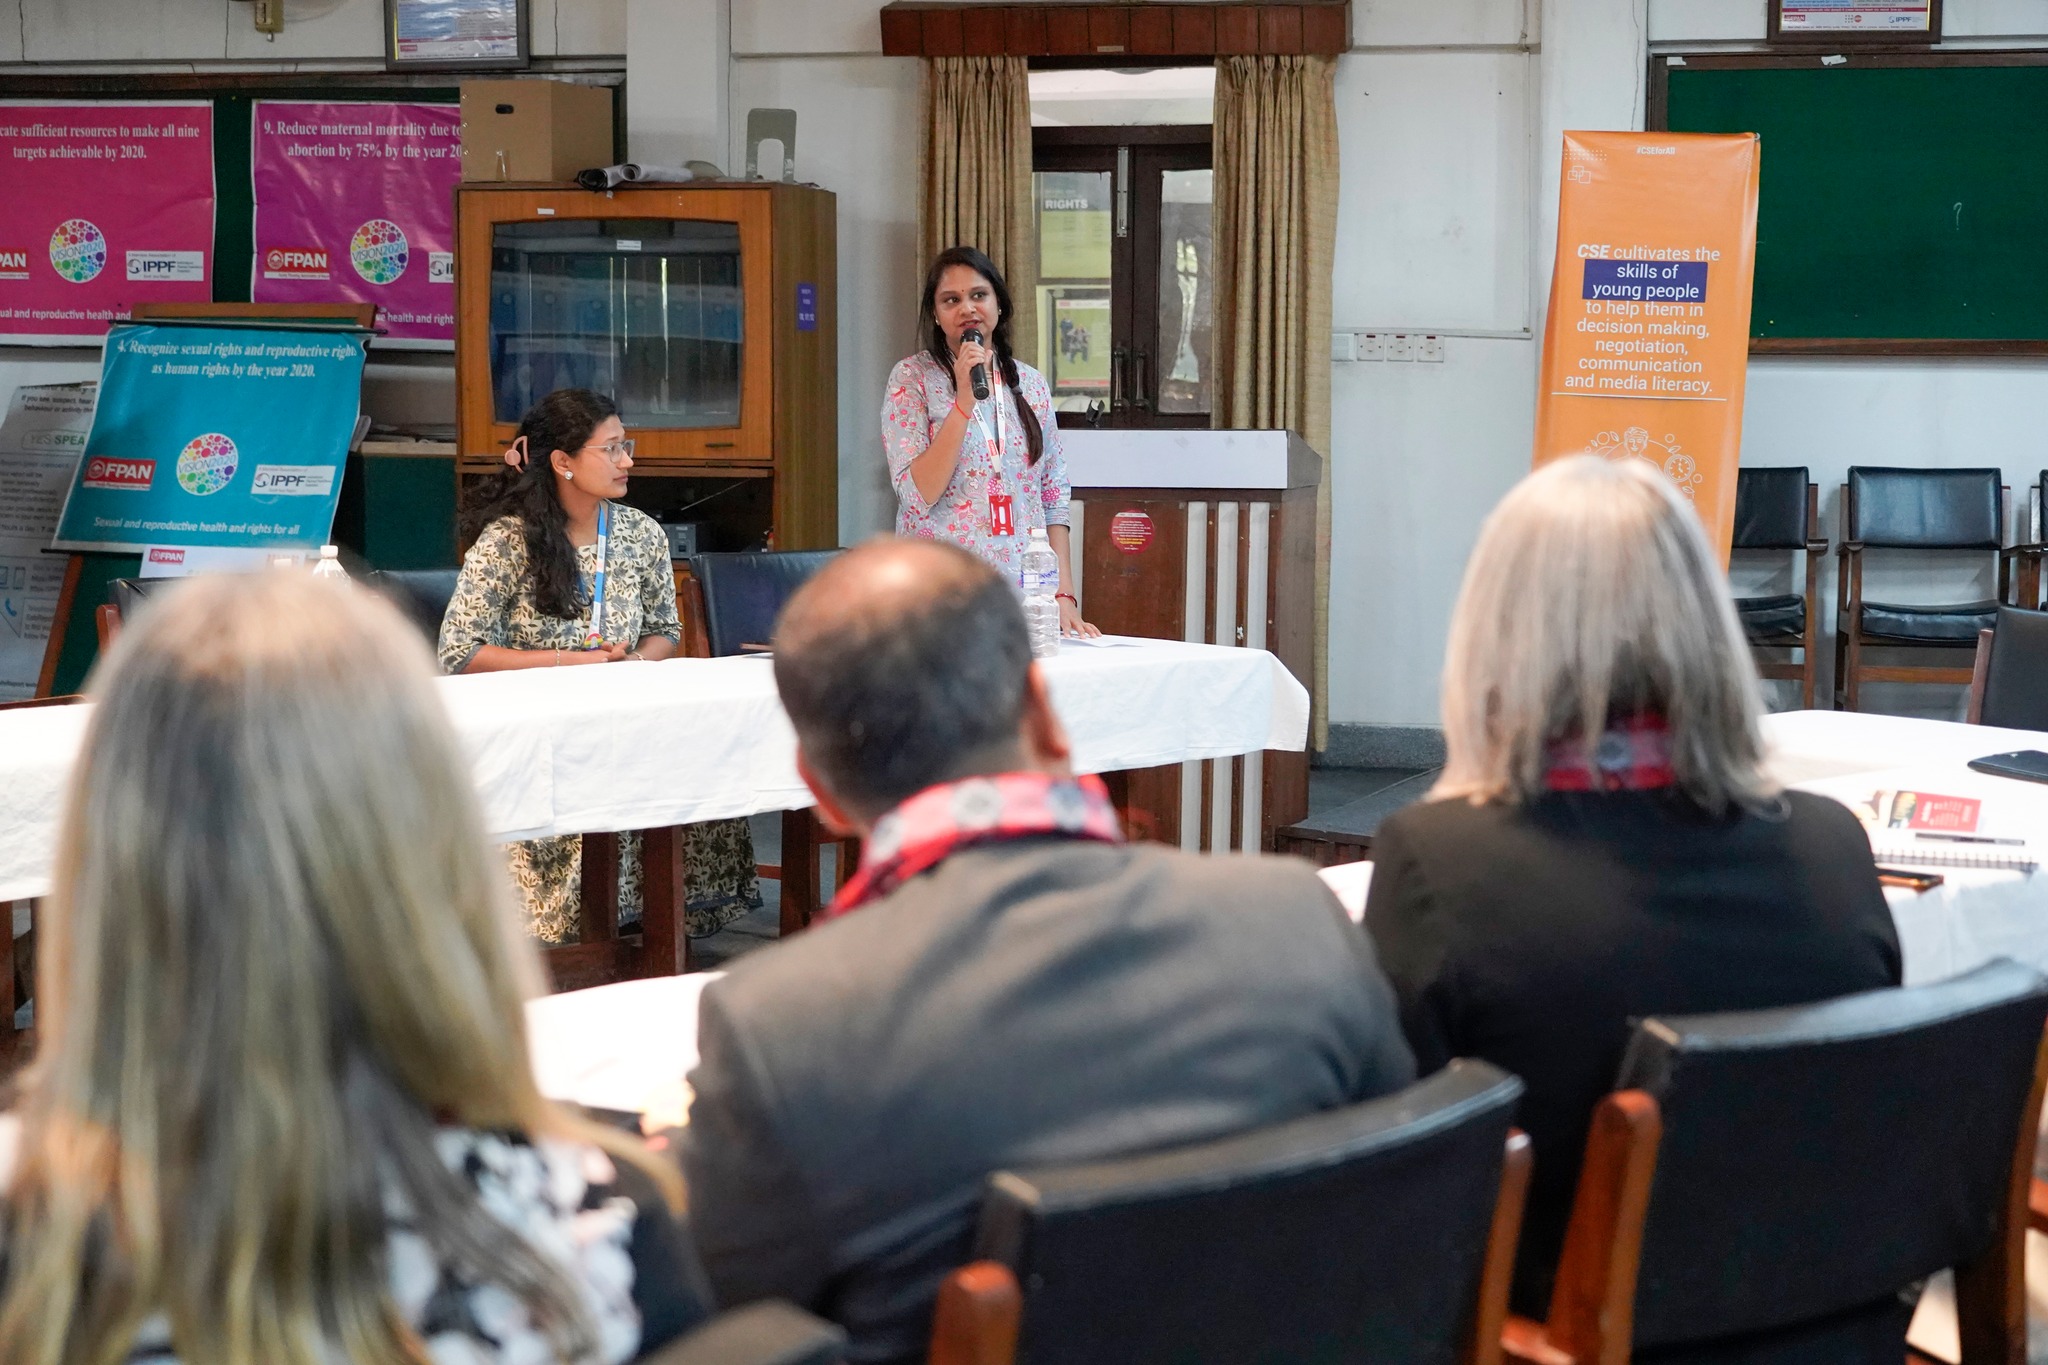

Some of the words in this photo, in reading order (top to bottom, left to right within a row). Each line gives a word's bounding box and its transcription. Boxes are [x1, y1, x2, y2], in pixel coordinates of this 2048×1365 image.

[21, 123, 67, 137] sufficient
[70, 126, 117, 137] resources
[120, 126, 130, 137] to
[132, 124, 160, 138] make
[162, 123, 175, 137] all
[178, 124, 200, 138] nine
[264, 121, 274, 134] 9.
[277, 121, 317, 135] Reduce
[321, 122, 372, 136] maternal
[376, 122, 427, 139] mortality
[430, 122, 449, 137] due
[13, 146, 47, 161] targets
[49, 145, 103, 158] achievable
[105, 145, 117, 162] by
[120, 145, 147, 159] 2020.
[288, 143, 335, 157] abortion
[339, 143, 353, 161] by
[356, 143, 382, 158] 75%
[385, 144, 399, 161] by
[402, 144, 420, 158] the
[423, 147, 447, 161] year
[1045, 198, 1089, 210] RIGHTS
[284, 252, 327, 268] FPAN
[1577, 244, 1611, 258] CSE
[1613, 245, 1690, 260] cultivates
[1695, 246, 1721, 261] the
[143, 261, 176, 272] IPPF
[1616, 263, 1657, 279] skills
[1662, 264, 1679, 279] of
[1592, 284, 1642, 300] young
[1646, 283, 1700, 301] people
[14, 308, 30, 319] and
[32, 309, 85, 320] reproductive
[87, 309, 114, 320] health
[115, 311, 131, 320] and
[1586, 301, 1602, 314] to
[1606, 300, 1640, 318] help
[1644, 302, 1684, 317] them
[1689, 302, 1704, 317] in
[387, 312, 414, 323] health
[416, 313, 432, 324] and
[1576, 318, 1643, 334] decision
[1647, 320, 1710, 339] making,
[118, 340, 126, 352] 4.
[129, 340, 180, 357] Recognize
[181, 342, 212, 355] sexual
[213, 342, 242, 359] rights
[244, 343, 265, 356] and
[266, 344, 330, 360] reproductive
[1595, 338, 1689, 356] negotiation,
[152, 364, 163, 374] as
[165, 362, 199, 375] human
[201, 362, 230, 378] rights
[232, 363, 245, 379] by
[247, 363, 263, 376] the
[264, 366, 288, 380] year
[289, 364, 316, 378] 2020.
[1578, 357, 1703, 373] communication
[1565, 373, 1595, 389] and
[1599, 375, 1648, 390] media
[1651, 376, 1713, 395] literacy.
[54, 434, 85, 446] SPEA
[105, 462, 152, 480] FPAN
[270, 475, 306, 487] IPPF
[94, 516, 124, 527] Sexual
[123, 519, 142, 529] and
[142, 520, 198, 532] reproductive
[199, 521, 228, 533] health
[228, 523, 247, 534] and
[247, 523, 272, 536] rights
[273, 523, 287, 535] for
[288, 524, 301, 535] all
[160, 552, 184, 561] FPAN
